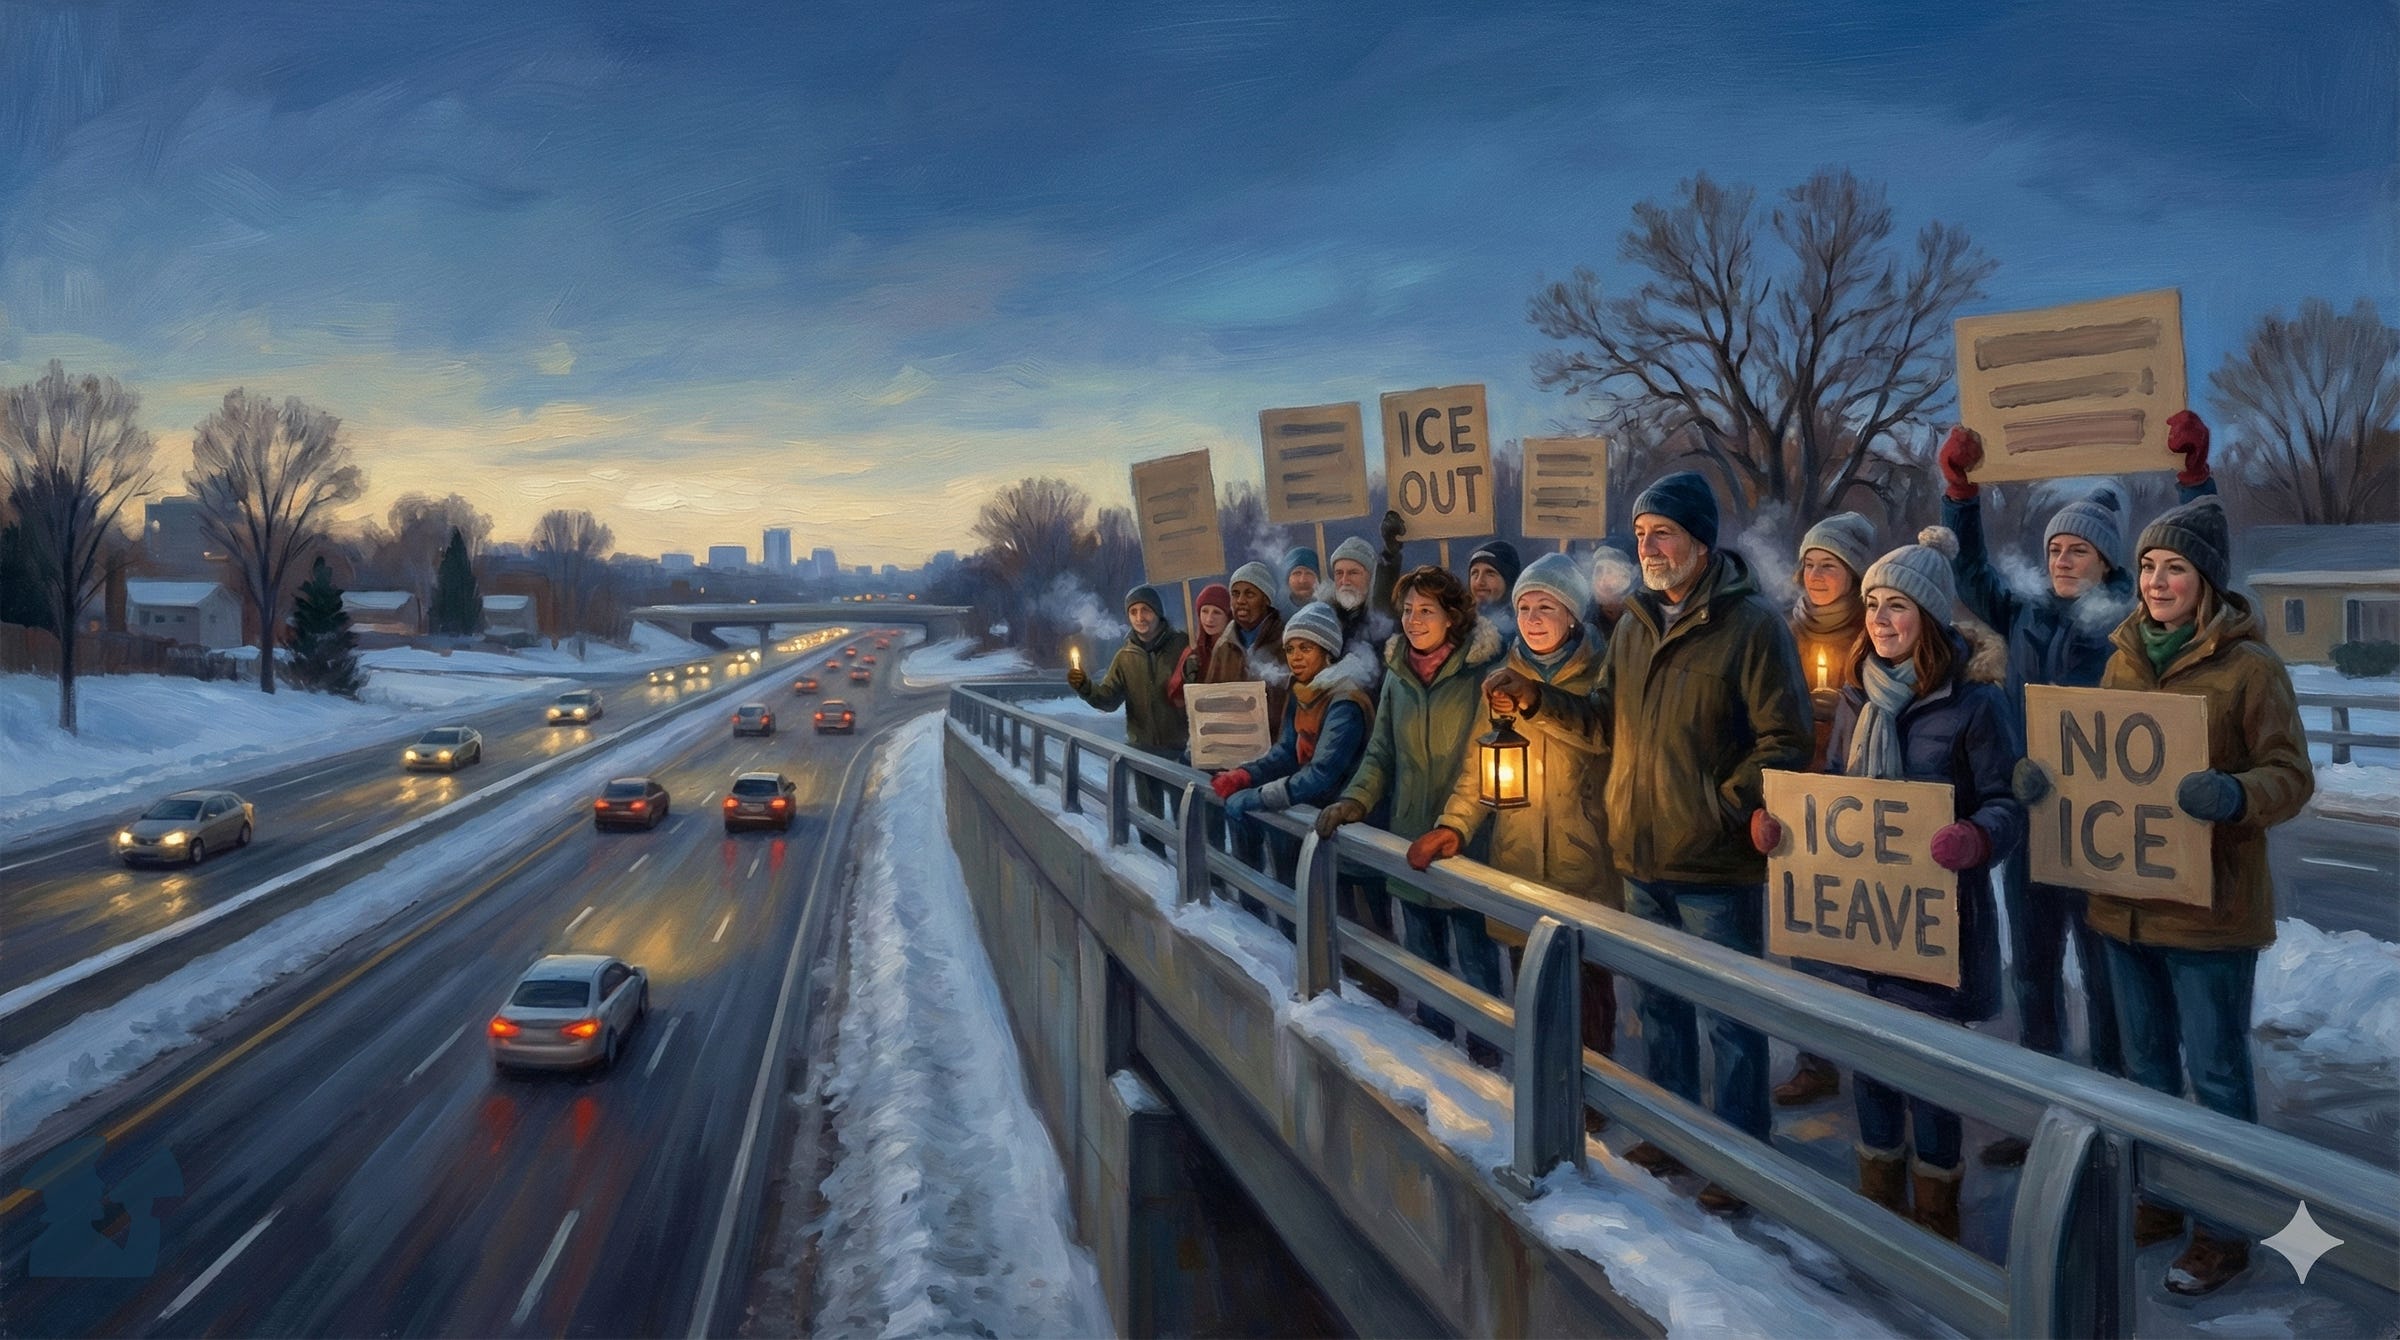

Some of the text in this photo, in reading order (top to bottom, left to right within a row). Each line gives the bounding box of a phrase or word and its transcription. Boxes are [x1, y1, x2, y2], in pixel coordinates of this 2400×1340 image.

[1398, 405, 1476, 457] ICE
[1398, 465, 1484, 515] OUT
[2060, 709, 2166, 786] NO
[1803, 793, 1912, 864] ICE
[2058, 796, 2176, 881] ICE
[1783, 870, 1946, 957] LEAVE
